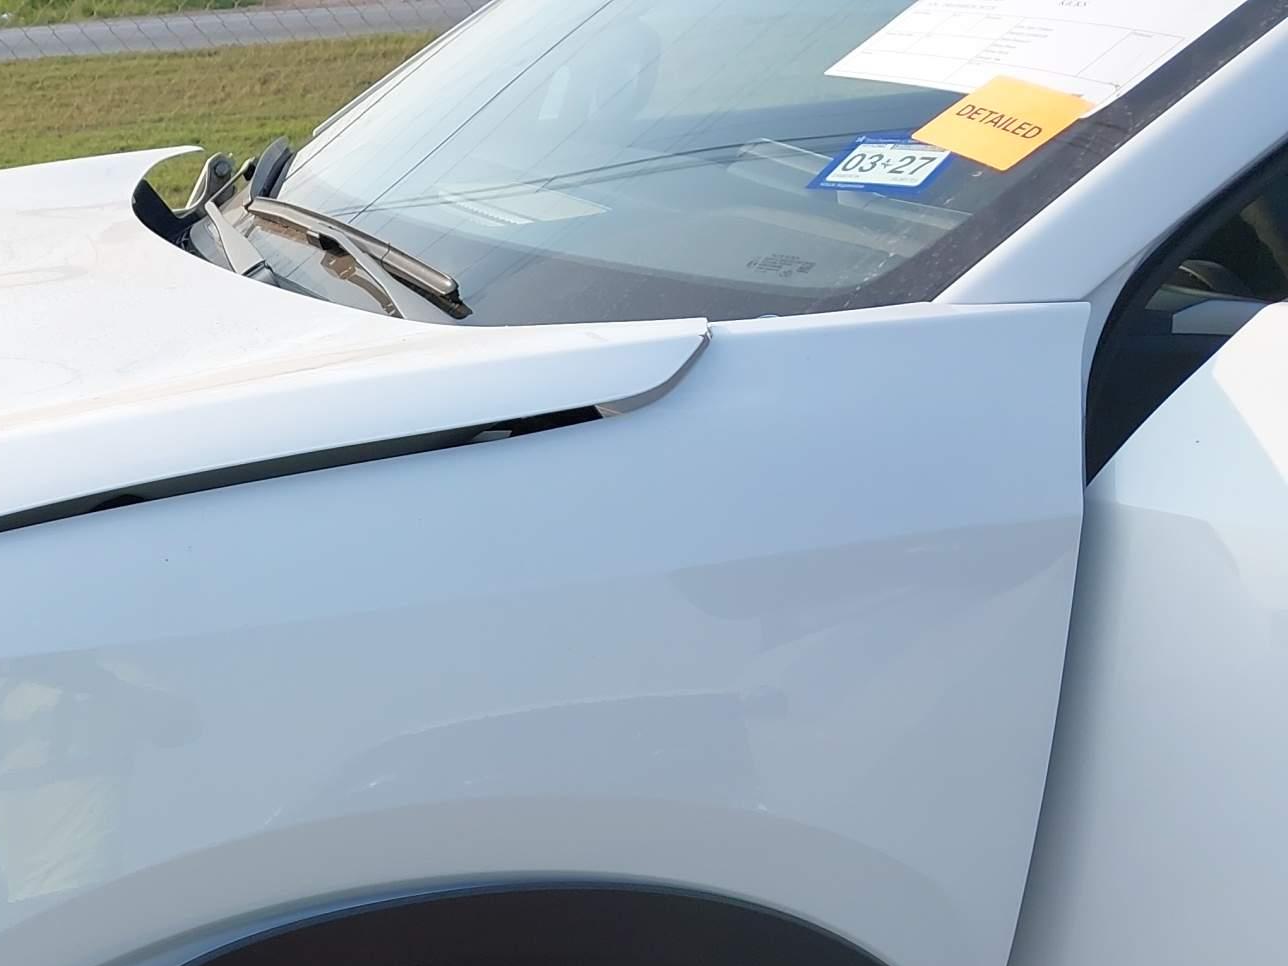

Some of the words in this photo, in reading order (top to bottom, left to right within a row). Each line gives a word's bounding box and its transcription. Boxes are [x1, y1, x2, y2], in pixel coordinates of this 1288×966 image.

[956, 104, 1043, 139] DETAILED
[841, 153, 884, 173] 03
[888, 155, 938, 175] 27
